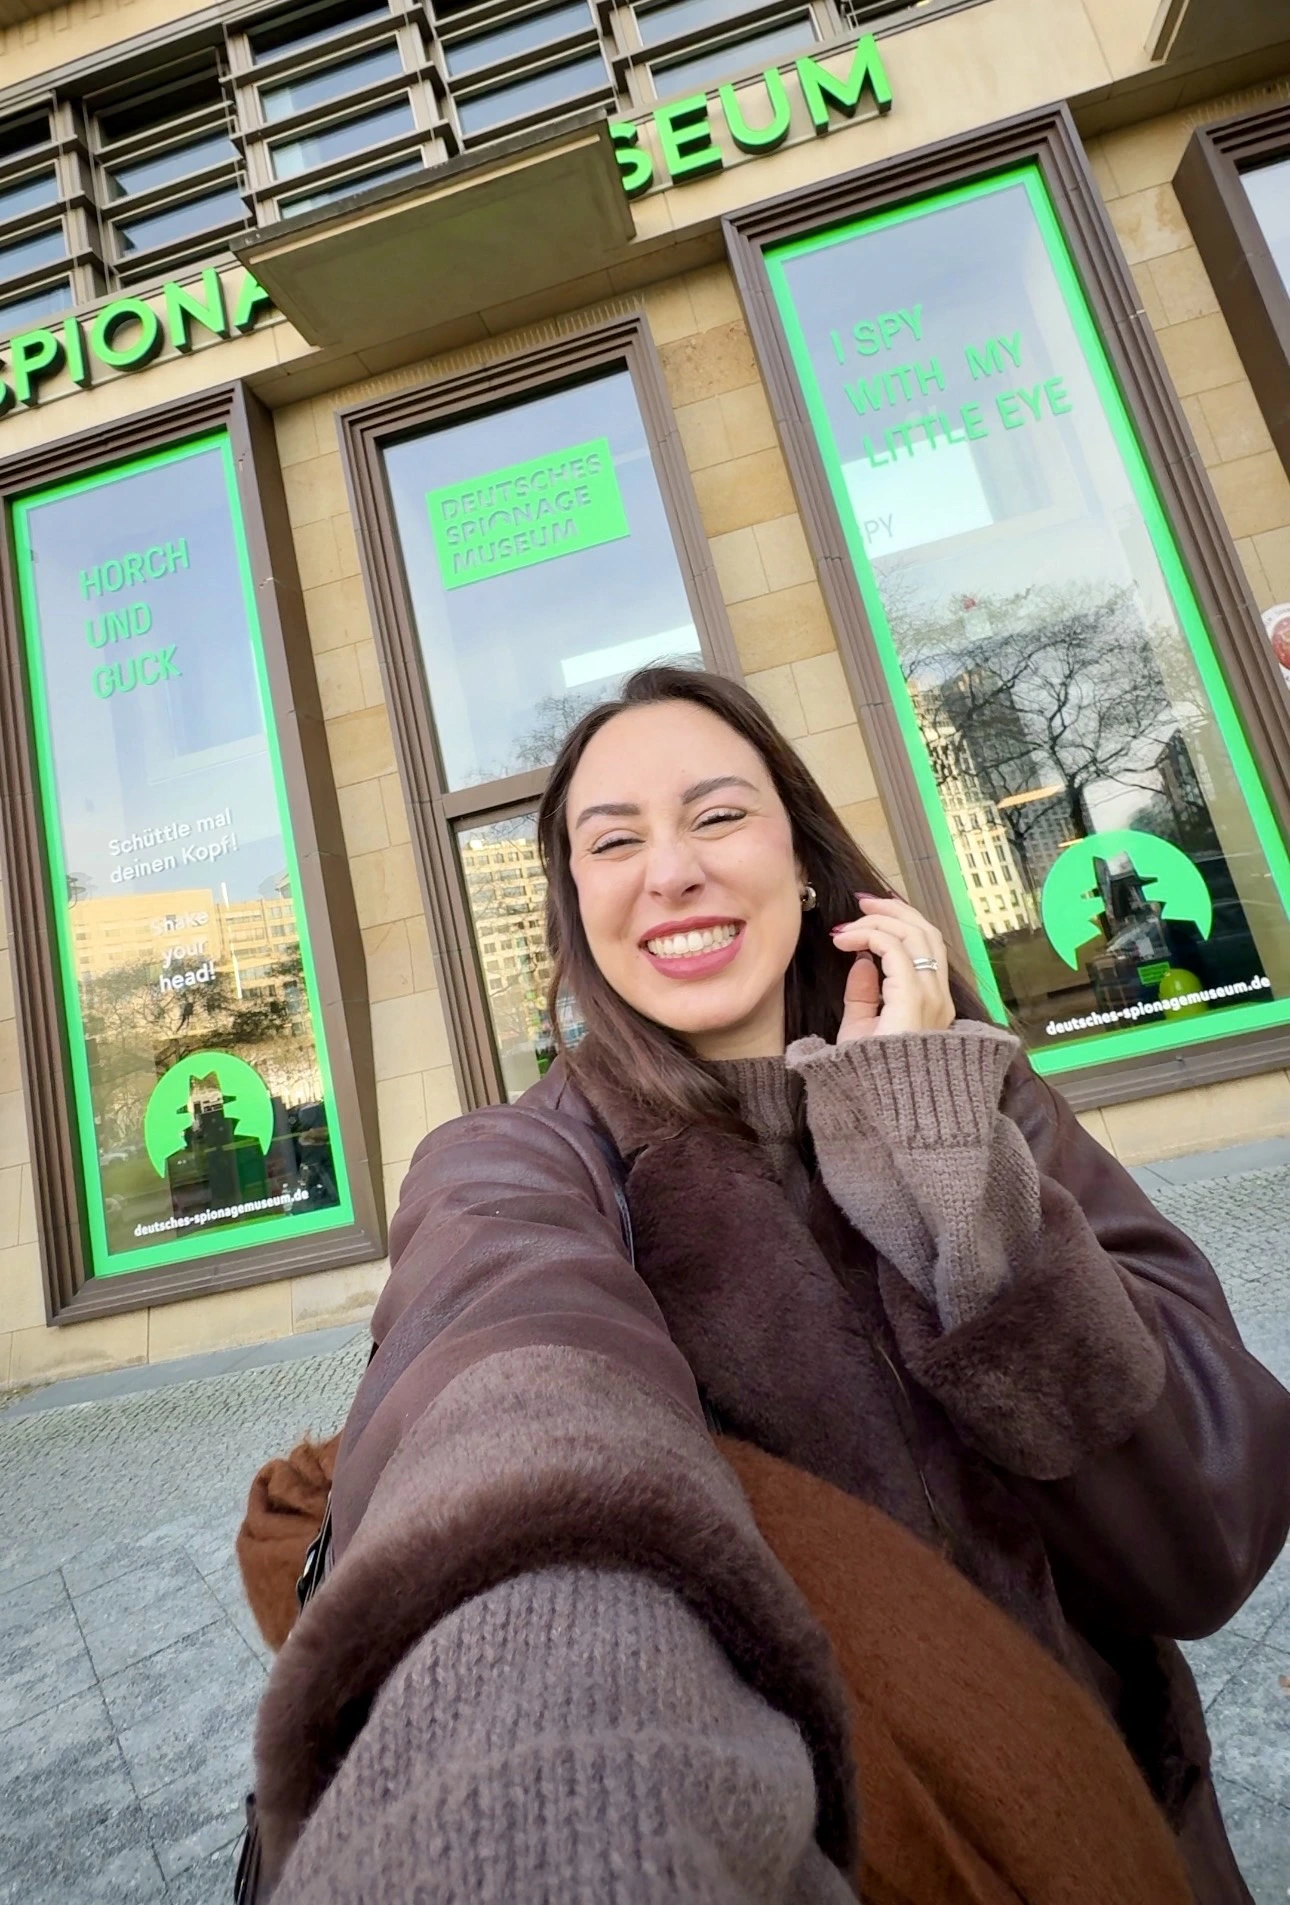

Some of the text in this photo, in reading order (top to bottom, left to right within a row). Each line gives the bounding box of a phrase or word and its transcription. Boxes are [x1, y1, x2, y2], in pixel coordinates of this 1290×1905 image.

[0, 266, 270, 416] PION
[830, 304, 923, 366] I SPY
[843, 330, 1022, 416] WITH MY
[862, 376, 1073, 468] LITTLE EYE
[441, 454, 602, 521] DEUTSCHES
[446, 485, 592, 546] SPIONAGE
[79, 537, 190, 601] HORCH
[453, 518, 580, 575] MUSEUM
[84, 602, 153, 649] UND
[91, 644, 183, 699] GUCK
[108, 808, 233, 857] Schüttle mal
[110, 832, 240, 884] deinen Kopf!
[149, 910, 210, 936] Shake
[159, 961, 217, 993] head!
[162, 940, 208, 968] your
[1045, 974, 1272, 1036] deutsches-spionagemuseum.de
[133, 1188, 310, 1237] deutsches-spionagemuseum.de
